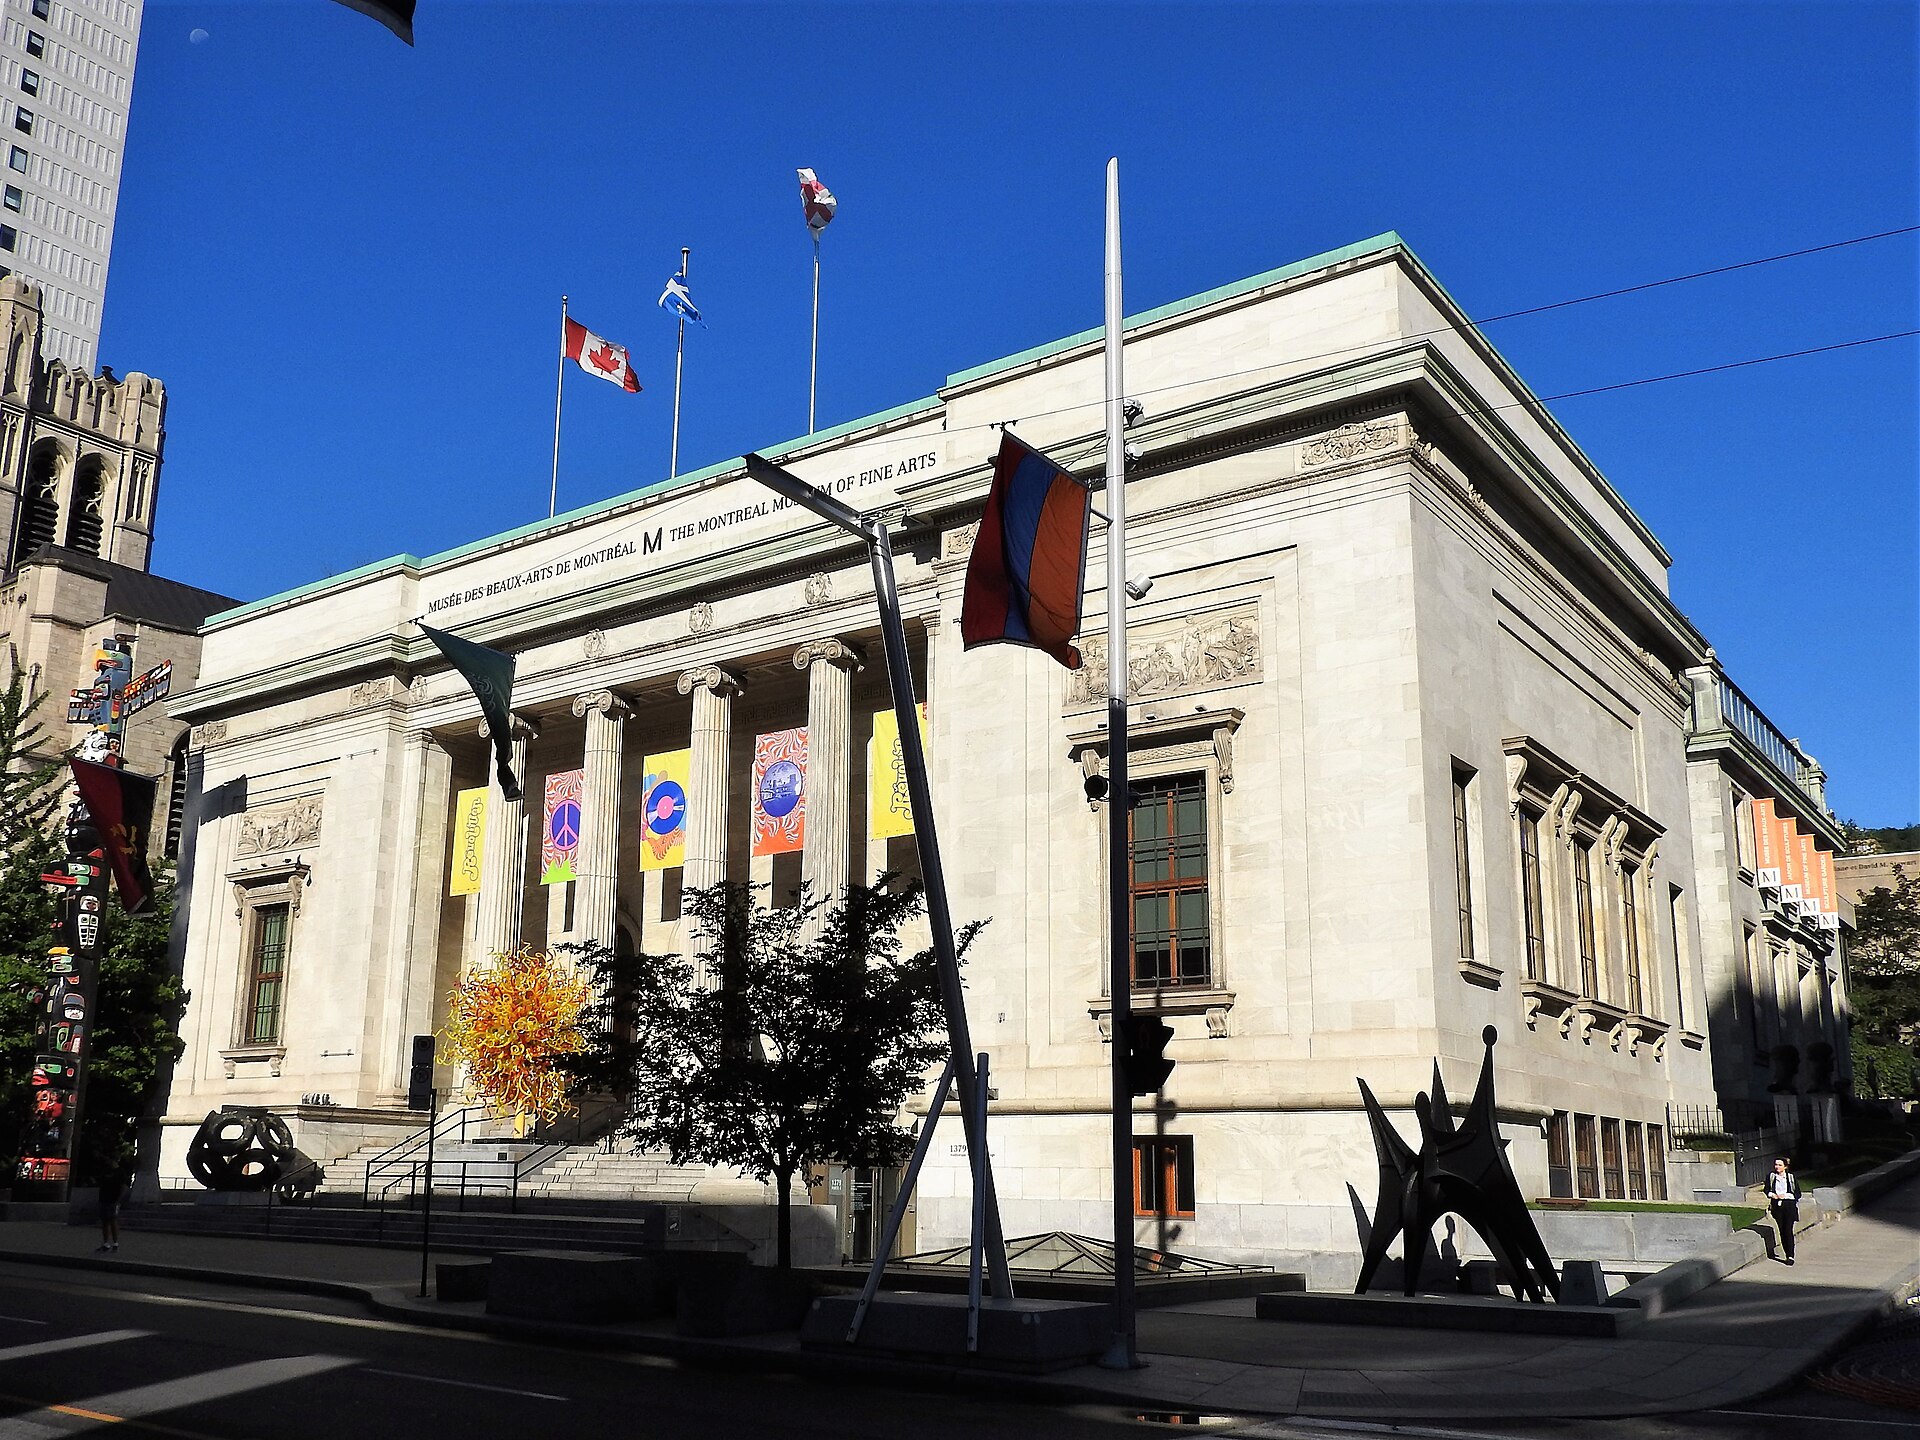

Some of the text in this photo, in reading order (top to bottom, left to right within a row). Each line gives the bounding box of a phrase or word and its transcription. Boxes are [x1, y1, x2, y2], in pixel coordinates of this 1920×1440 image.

[669, 451, 936, 542] THE MONTREAL MUM OF FINE ARTS
[642, 527, 663, 556] M
[428, 541, 637, 614] MUSÉE DES BEAUX-ARTS DE MONTRÉAL
[950, 1144, 967, 1153] 1379
